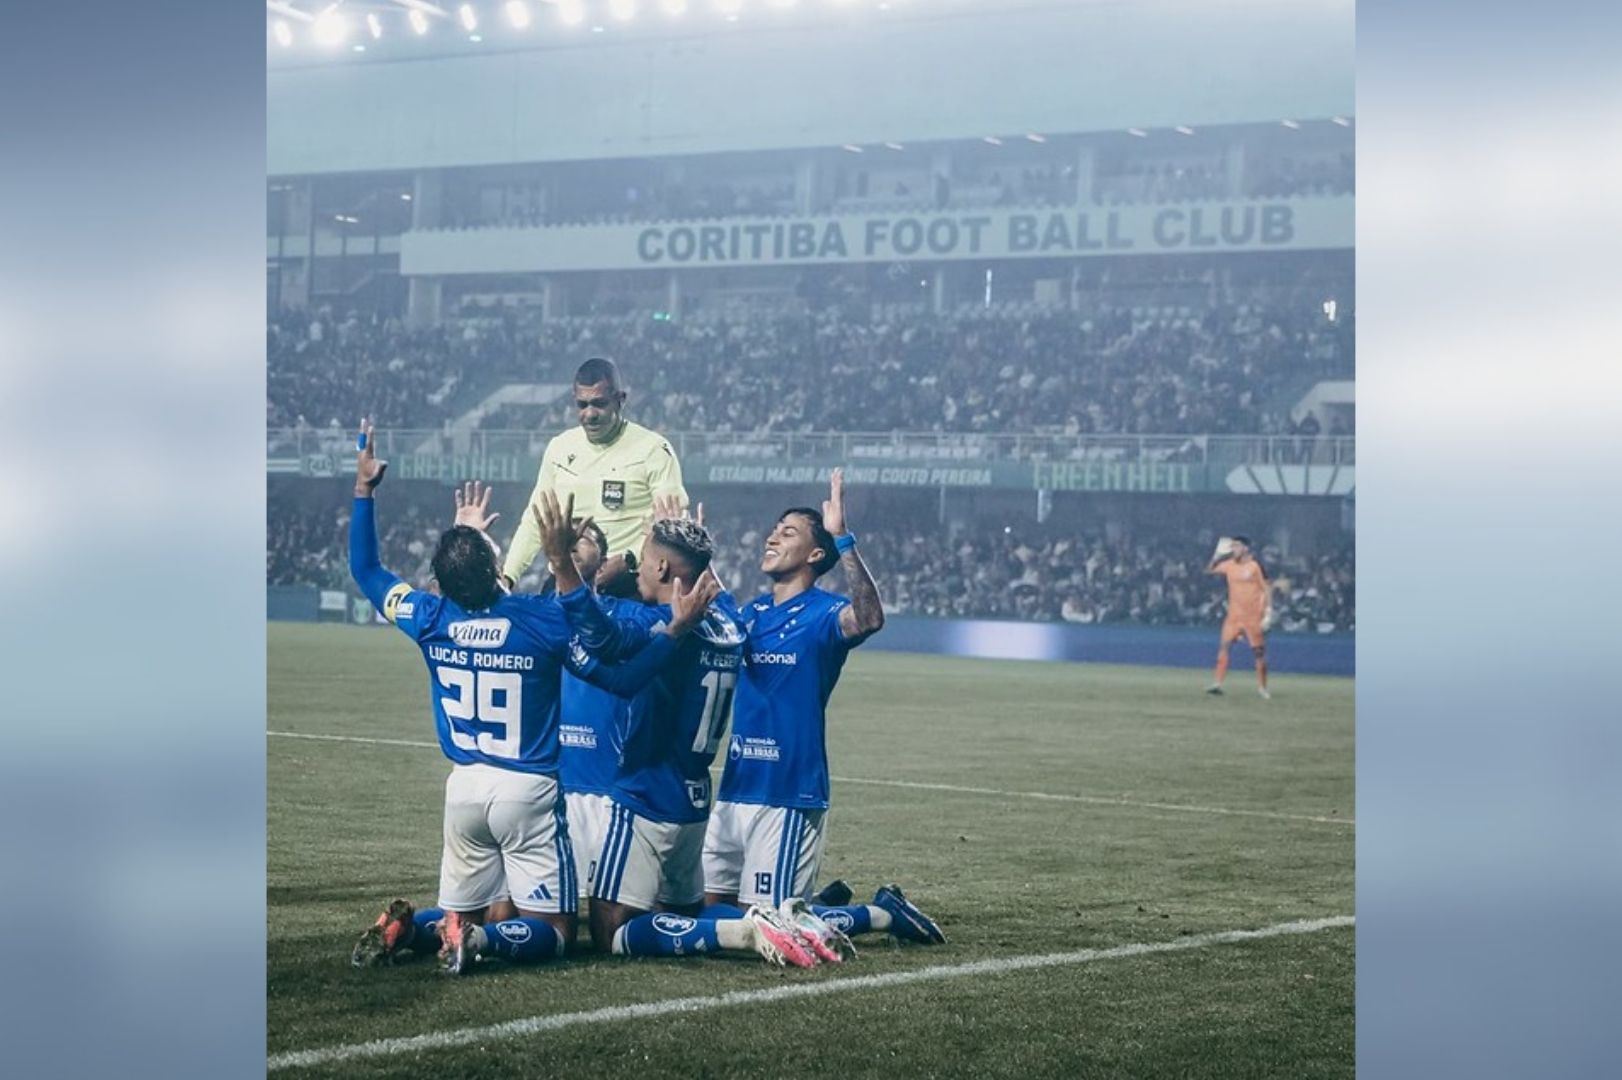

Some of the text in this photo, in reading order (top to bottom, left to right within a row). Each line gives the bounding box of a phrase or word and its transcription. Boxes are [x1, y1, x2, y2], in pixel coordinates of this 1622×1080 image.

[637, 203, 1296, 264] CORITIBA FOOT BALL CLUB
[400, 454, 466, 482] GREEN
[709, 465, 764, 483] ESTÁDIO
[766, 467, 814, 482] MAJOR
[880, 467, 929, 485] COUTO
[930, 468, 992, 486] PEREIRA
[1033, 461, 1125, 491] GREEN
[453, 624, 502, 641] Vilma
[429, 645, 535, 670] LUCAS ROMERO
[436, 665, 523, 760] 29
[755, 871, 773, 894] 19
